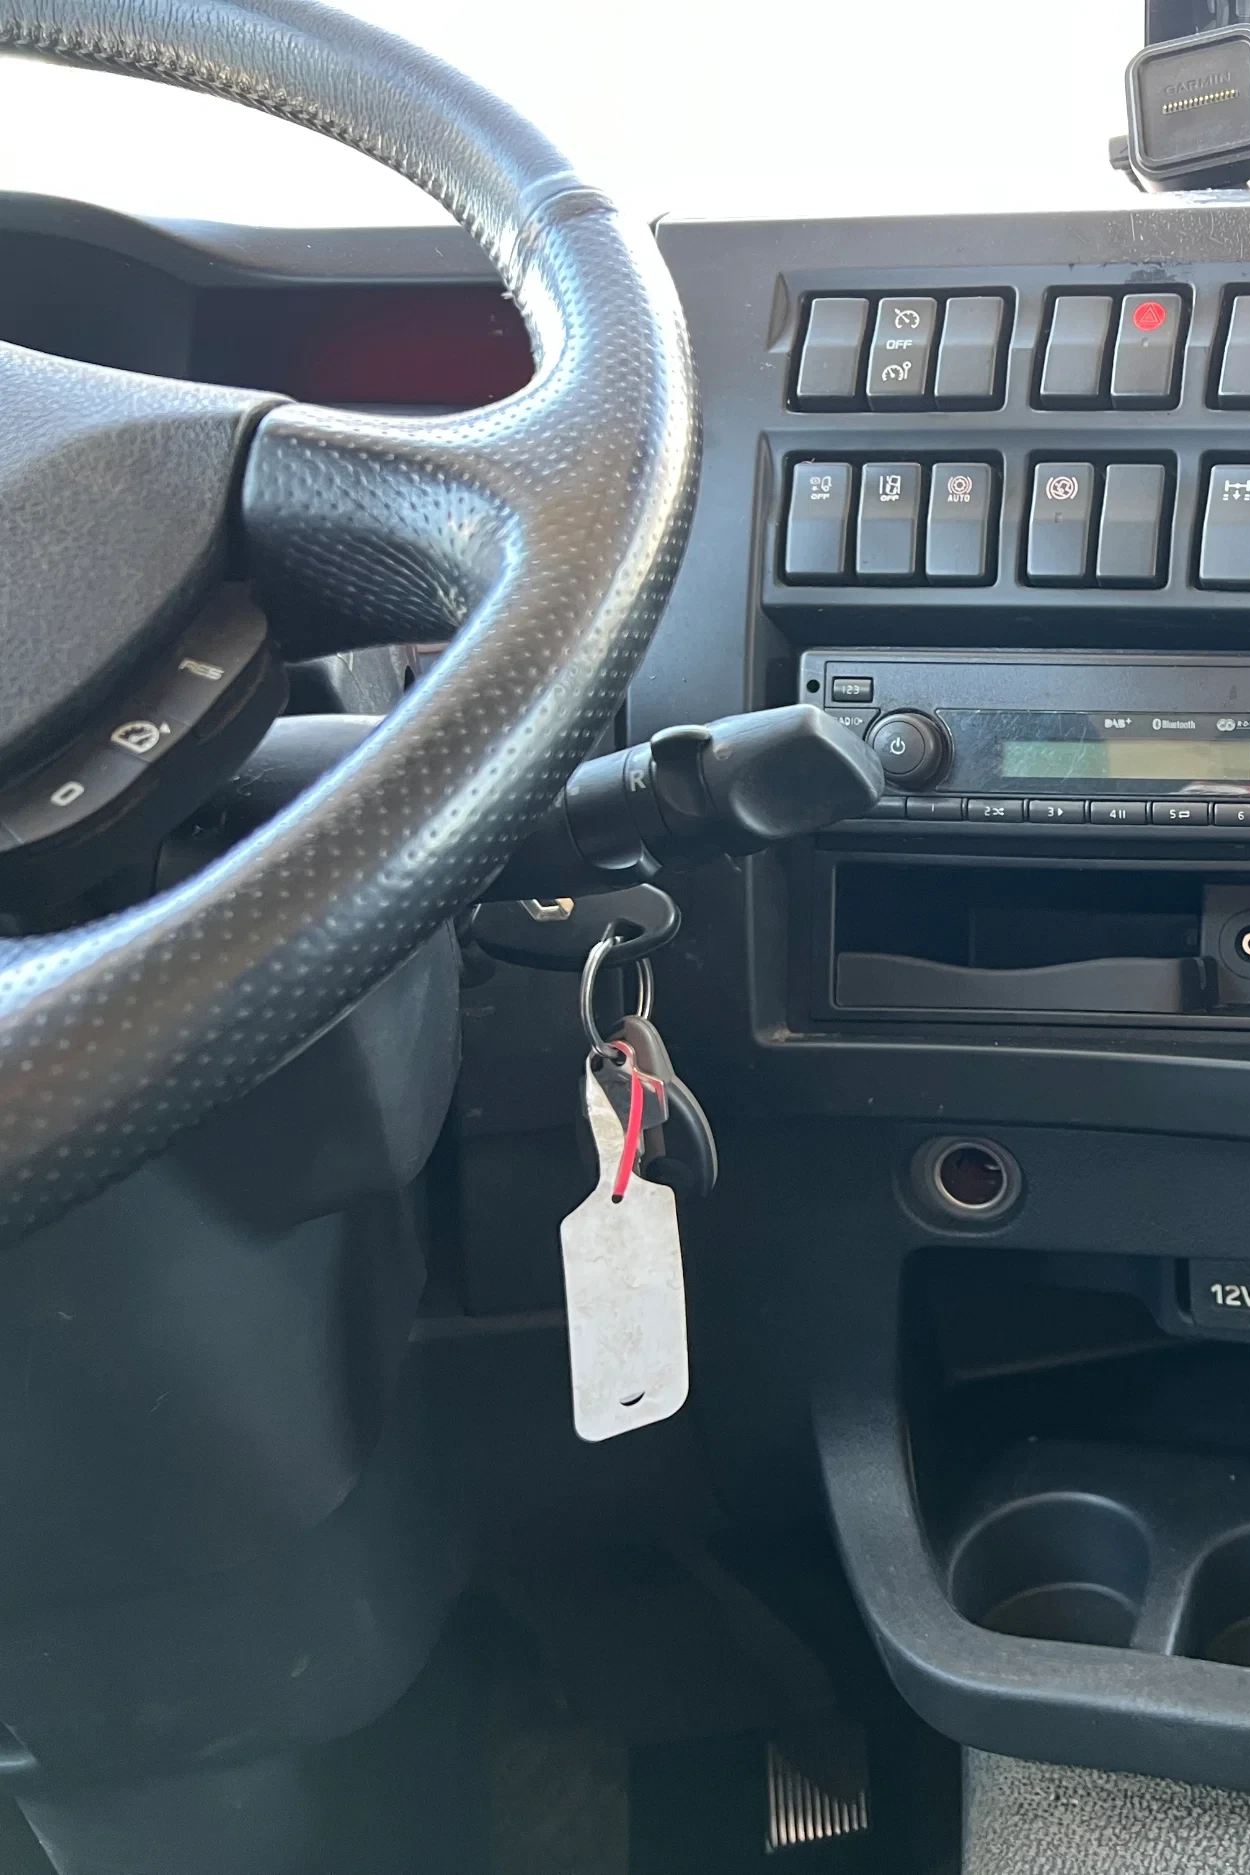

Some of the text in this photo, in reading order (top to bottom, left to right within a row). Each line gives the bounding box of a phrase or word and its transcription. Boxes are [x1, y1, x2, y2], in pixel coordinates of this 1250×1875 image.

[1164, 72, 1231, 96] GARMIN
[886, 339, 913, 350] OFF
[880, 494, 900, 502] OFF
[947, 494, 971, 502] AUTO
[841, 685, 860, 695] 123
[1104, 717, 1132, 729] DAB+
[1162, 719, 1196, 730] Bluetooth
[630, 769, 647, 792] R
[984, 806, 992, 816] 2
[1047, 807, 1055, 817] 3
[1109, 809, 1117, 818] 4
[1169, 810, 1177, 819] 5
[1237, 811, 1245, 820] 6
